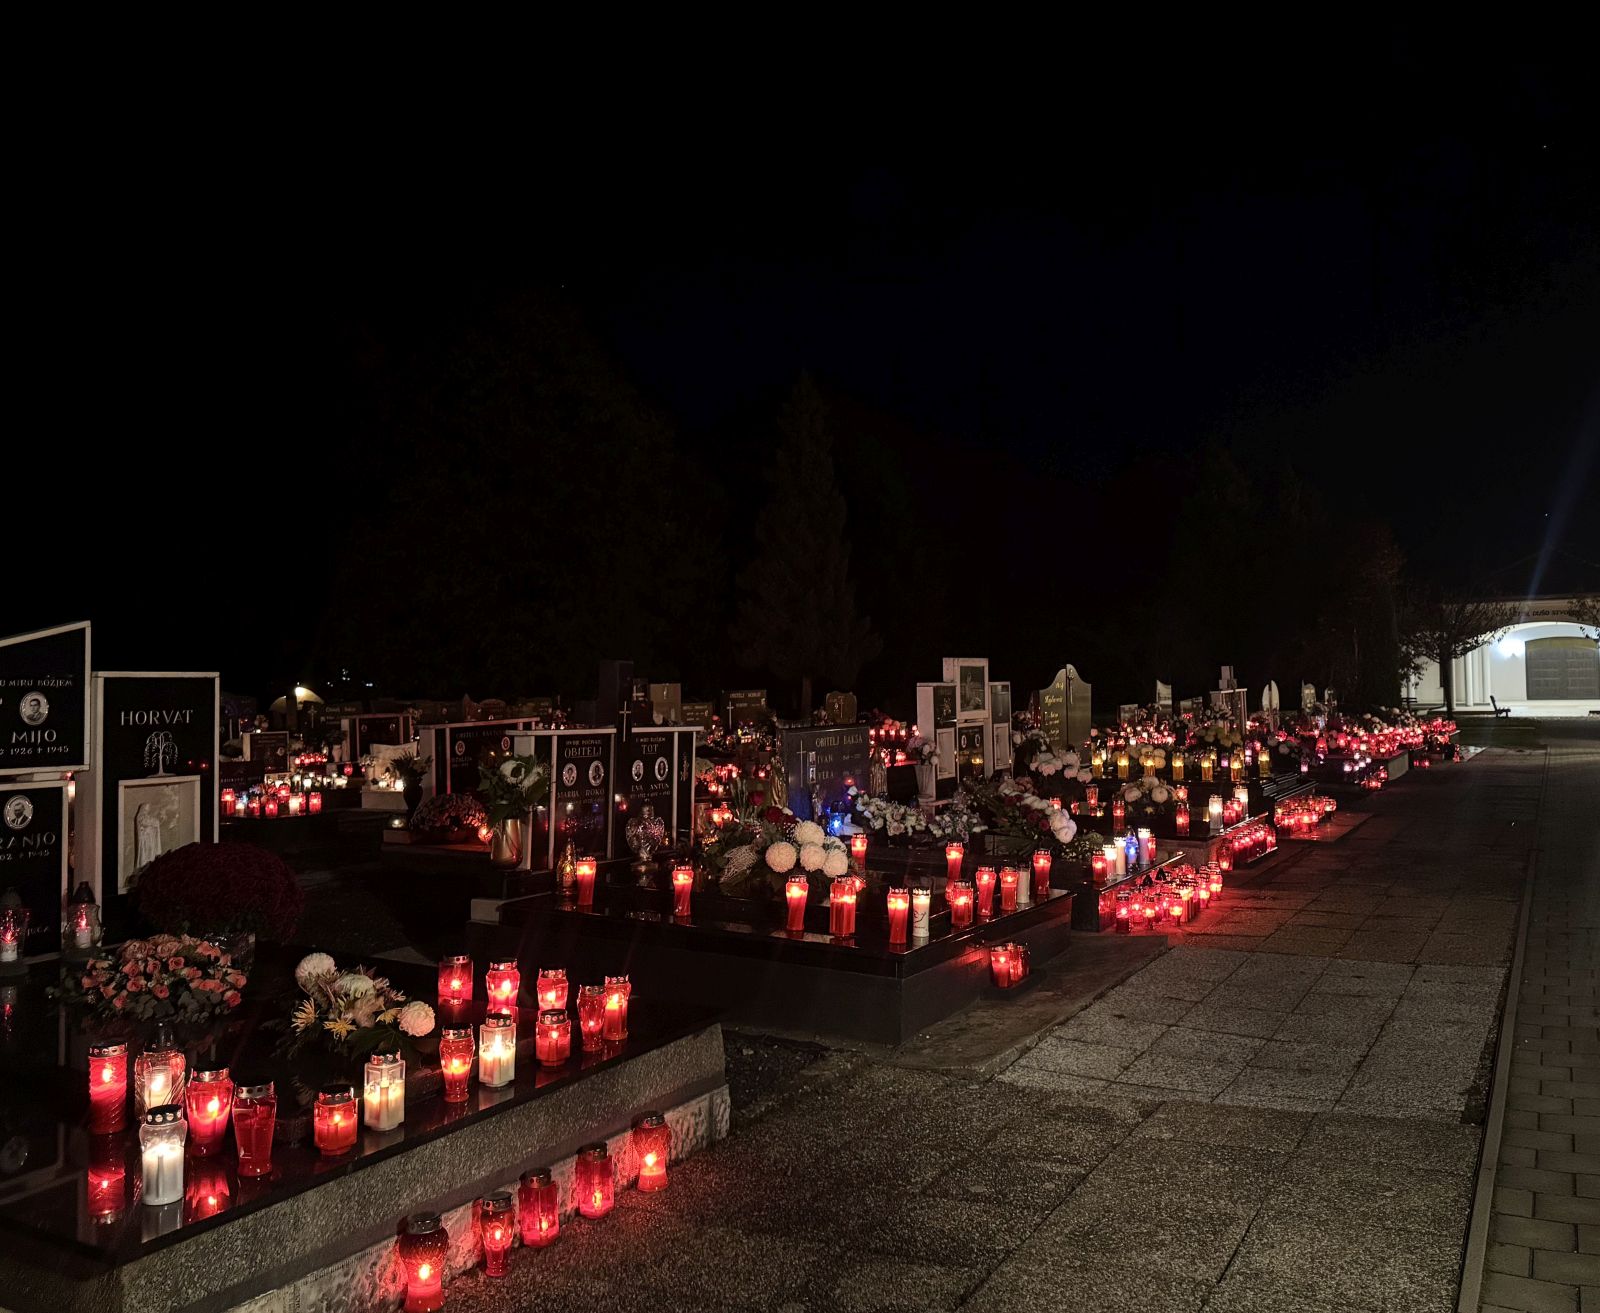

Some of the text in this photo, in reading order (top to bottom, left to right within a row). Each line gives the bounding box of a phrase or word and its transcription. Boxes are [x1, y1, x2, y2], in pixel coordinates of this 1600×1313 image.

[9, 679, 33, 687] MIRU
[120, 709, 194, 726] HORVAT
[11, 728, 57, 745] MIJO
[10, 745, 69, 755] 1926 1945
[641, 743, 658, 754] TOT
